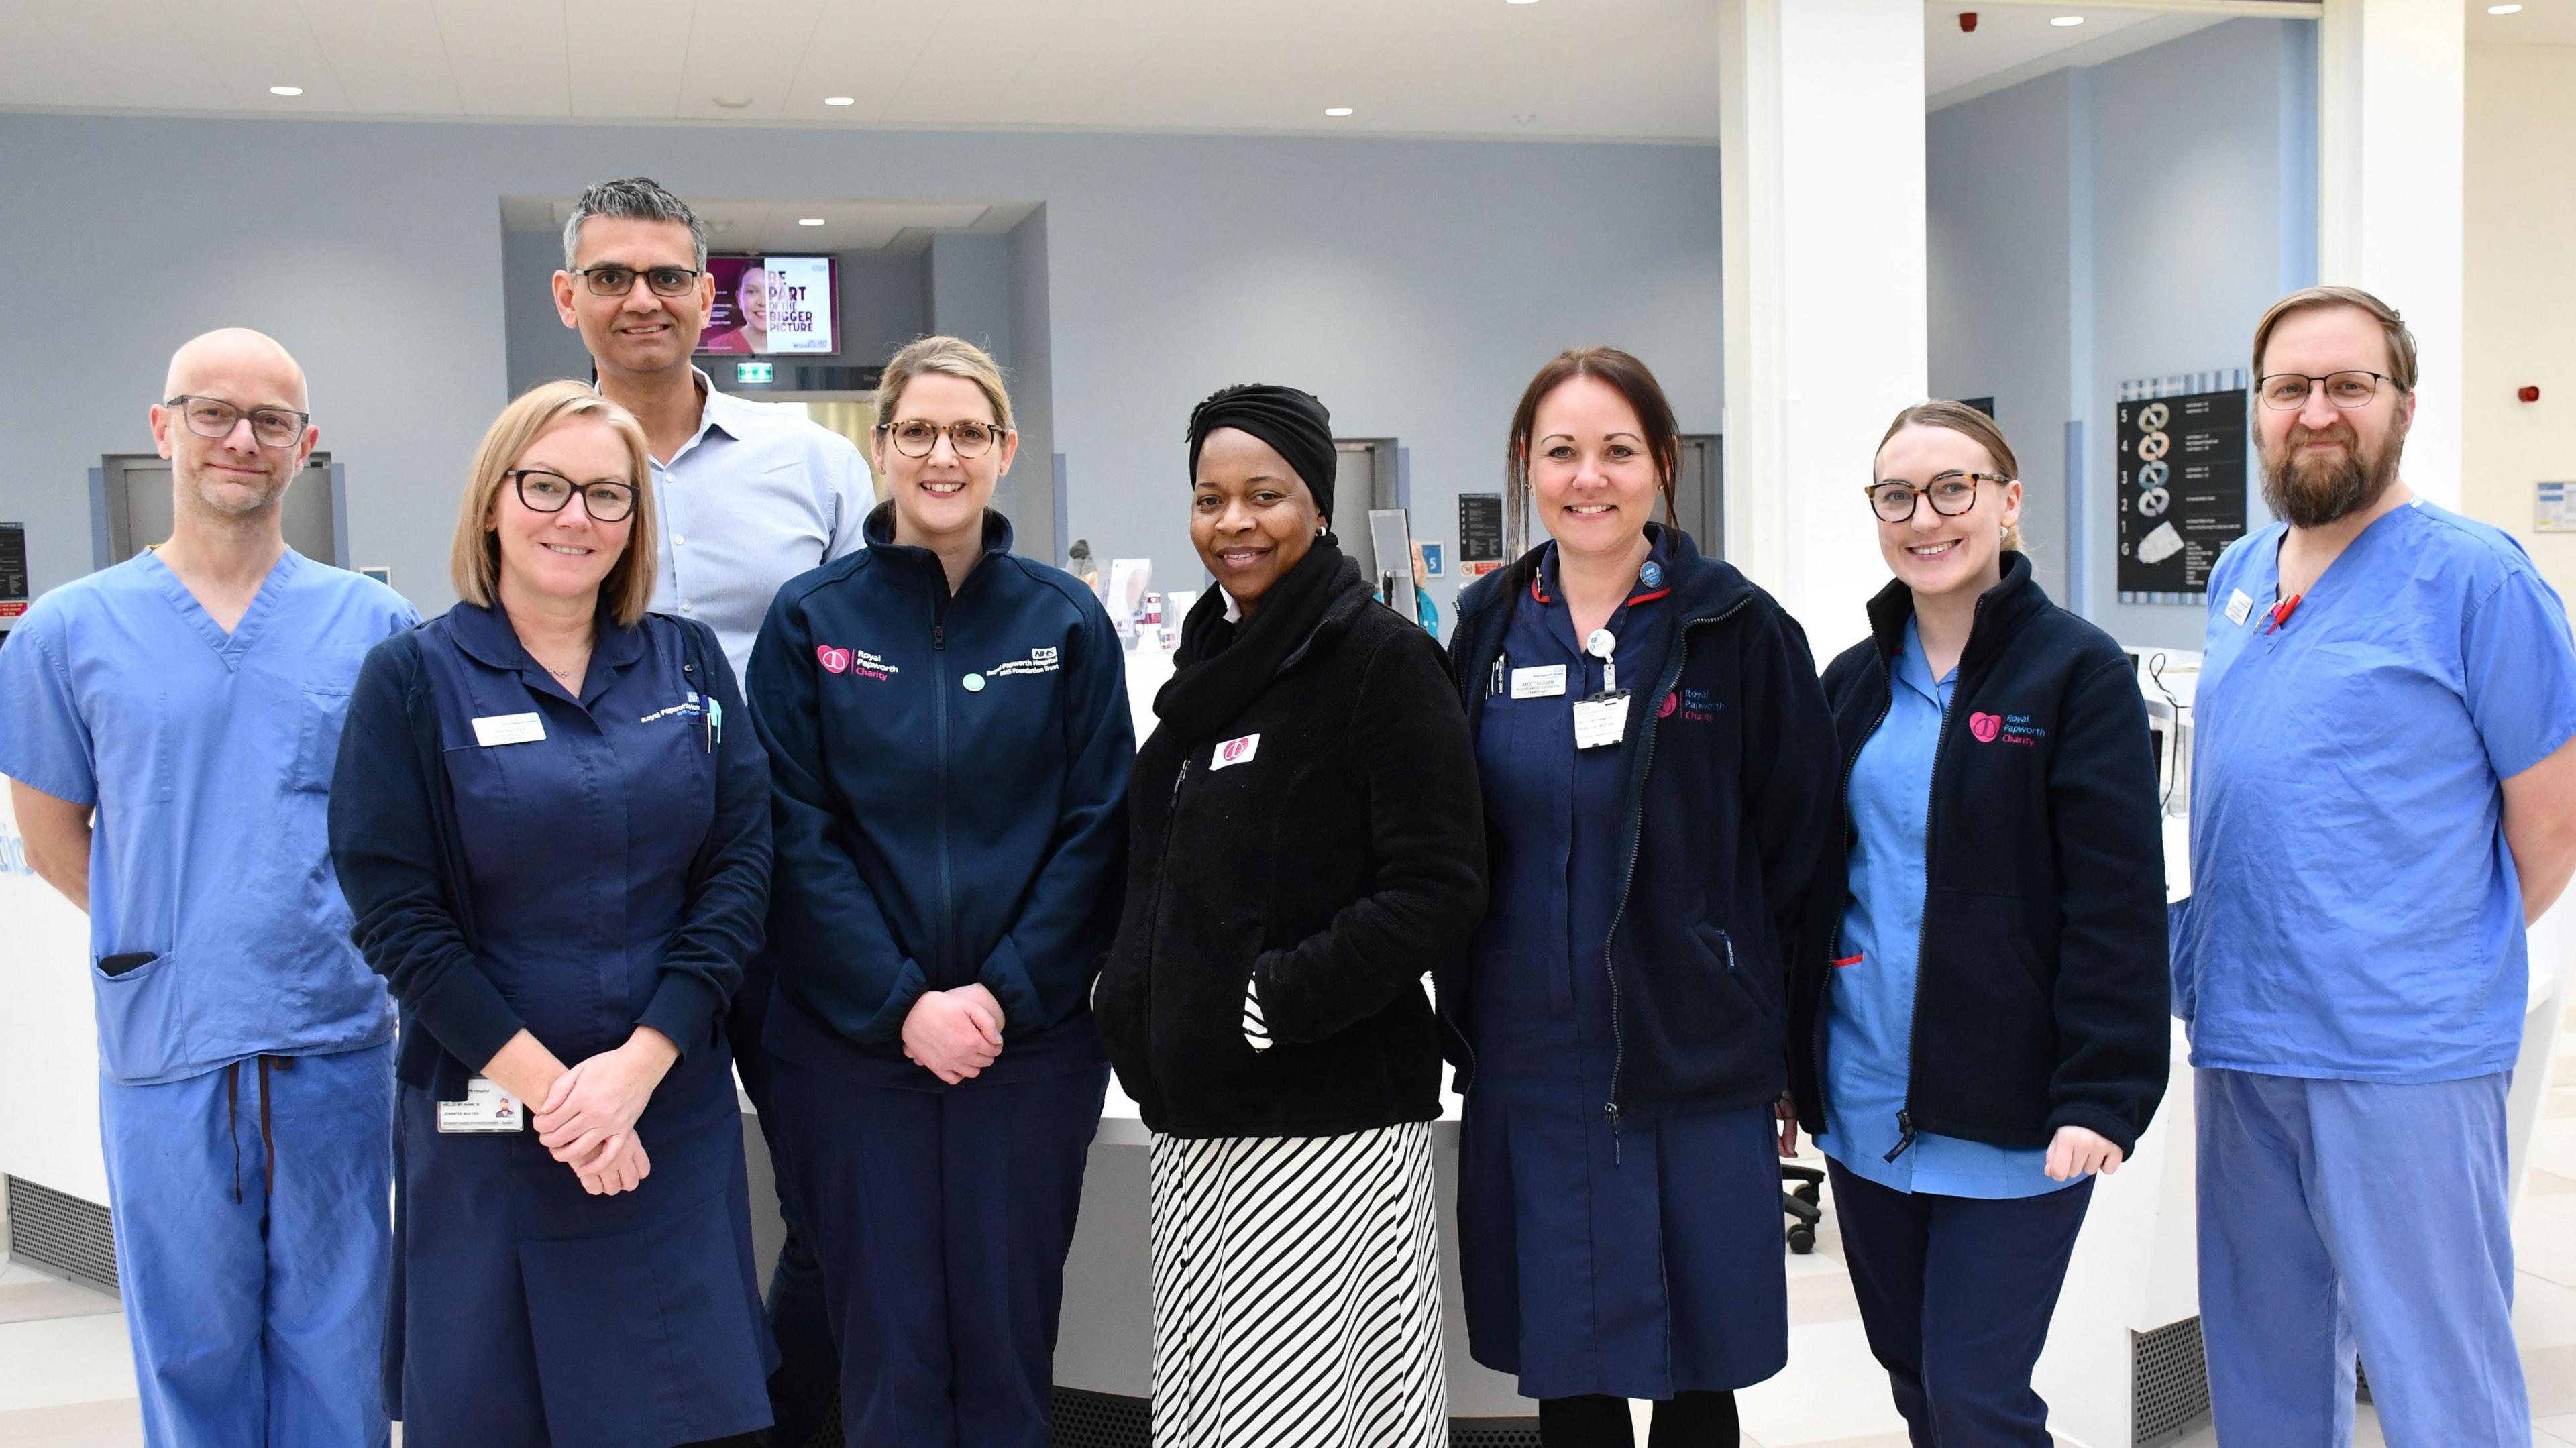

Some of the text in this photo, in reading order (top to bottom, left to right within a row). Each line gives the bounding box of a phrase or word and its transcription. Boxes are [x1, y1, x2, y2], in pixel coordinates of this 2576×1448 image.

[768, 271, 786, 285] BE
[769, 286, 806, 300] PART
[769, 311, 813, 321] BIGGER
[770, 323, 813, 332] PICTURE
[2121, 408, 2128, 423] 5
[2121, 439, 2128, 452] 4
[2121, 470, 2128, 484] 3
[2121, 498, 2128, 512] 2
[2121, 520, 2127, 533] 1
[2121, 542, 2129, 556] G
[1430, 557, 1436, 569] 5
[858, 650, 881, 662] Royal
[1034, 649, 1055, 658] NHS
[857, 658, 899, 673] Papworth
[986, 656, 1059, 676] Royal Papworth Hospital
[1044, 664, 1060, 672] Trust
[856, 667, 888, 681] Charity
[1685, 689, 1709, 700] Royal
[1685, 700, 1725, 710] Papworth
[641, 712, 661, 723] Royal
[1685, 711, 1713, 721] Charity
[2006, 714, 2029, 724] Royal
[2004, 724, 2045, 736] Papworth
[2002, 734, 2035, 746] Charity
